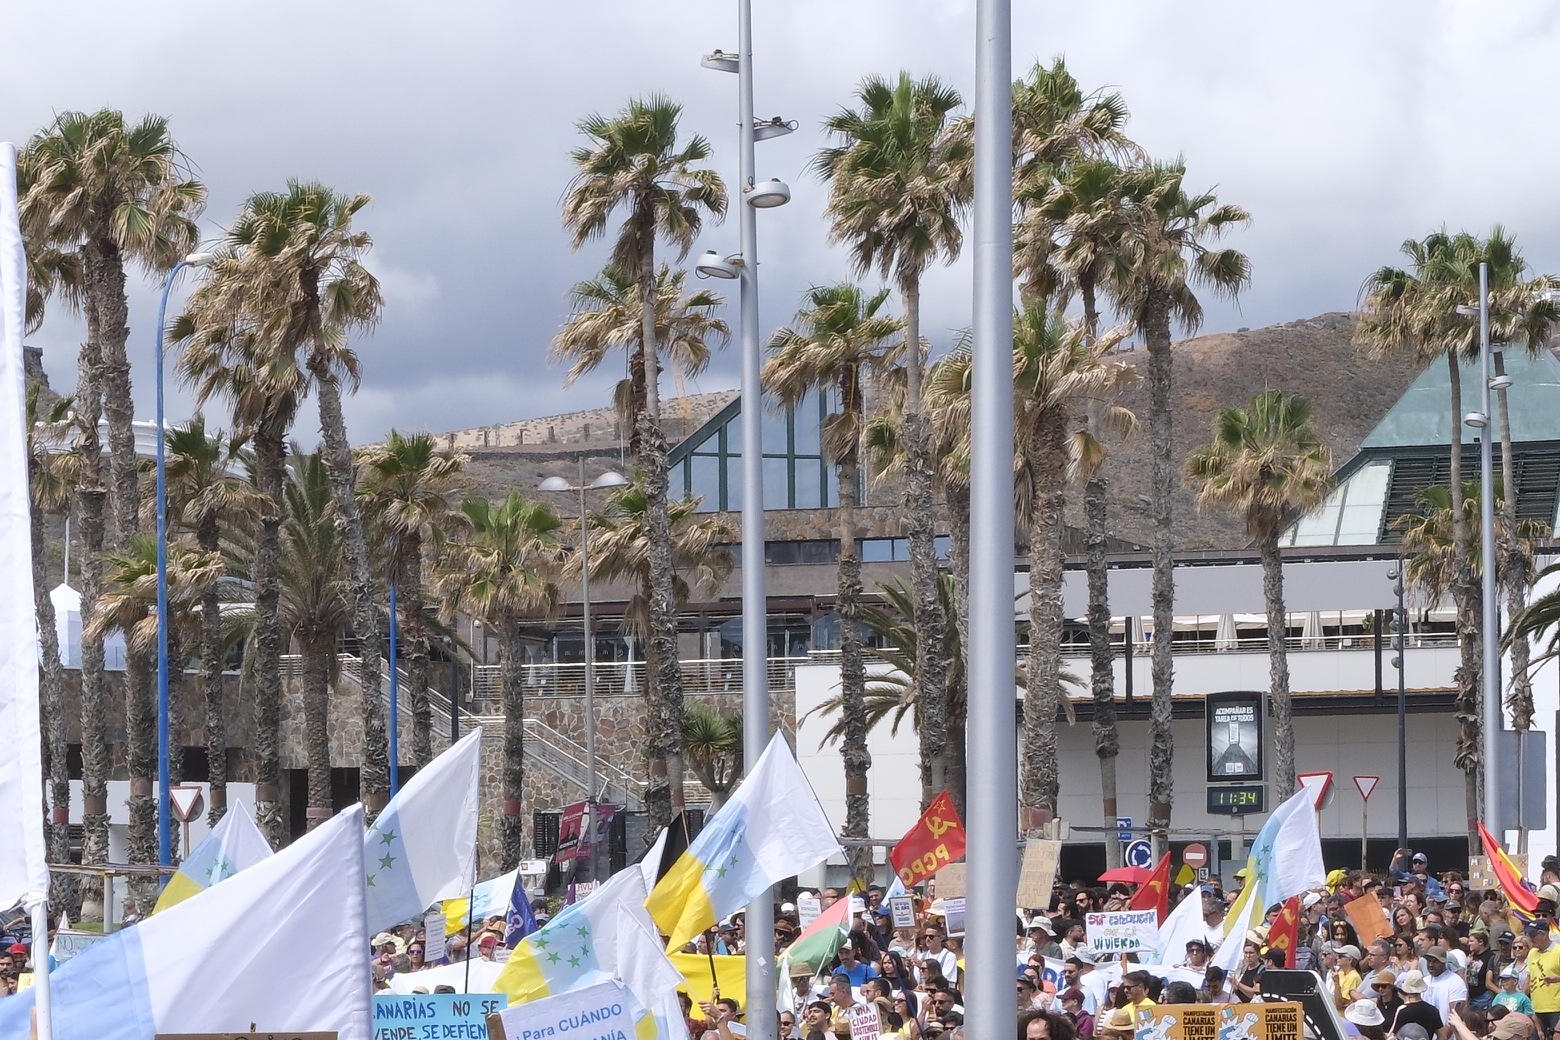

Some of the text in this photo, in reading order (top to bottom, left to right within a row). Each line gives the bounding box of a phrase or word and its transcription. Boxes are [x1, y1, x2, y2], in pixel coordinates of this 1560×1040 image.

[1215, 706, 1254, 715] ACOMPAÑAR ES
[1215, 714, 1230, 723] TAREA
[1237, 714, 1254, 722] TODOS
[1219, 792, 1256, 805] 11:34
[453, 1001, 470, 1016] NO
[480, 1001, 499, 1015] SE
[855, 1004, 871, 1016] UNA
[559, 1003, 622, 1032] CUÁNDO
[852, 1015, 877, 1027] CIUDAD
[1183, 1016, 1215, 1026] CANARIAS
[1265, 1013, 1297, 1023] CANARIAS
[422, 1025, 440, 1039] SE
[443, 1021, 487, 1040] DEFIEN
[1183, 1026, 1215, 1036] TIENE UN
[1265, 1022, 1297, 1033] TIENE UN
